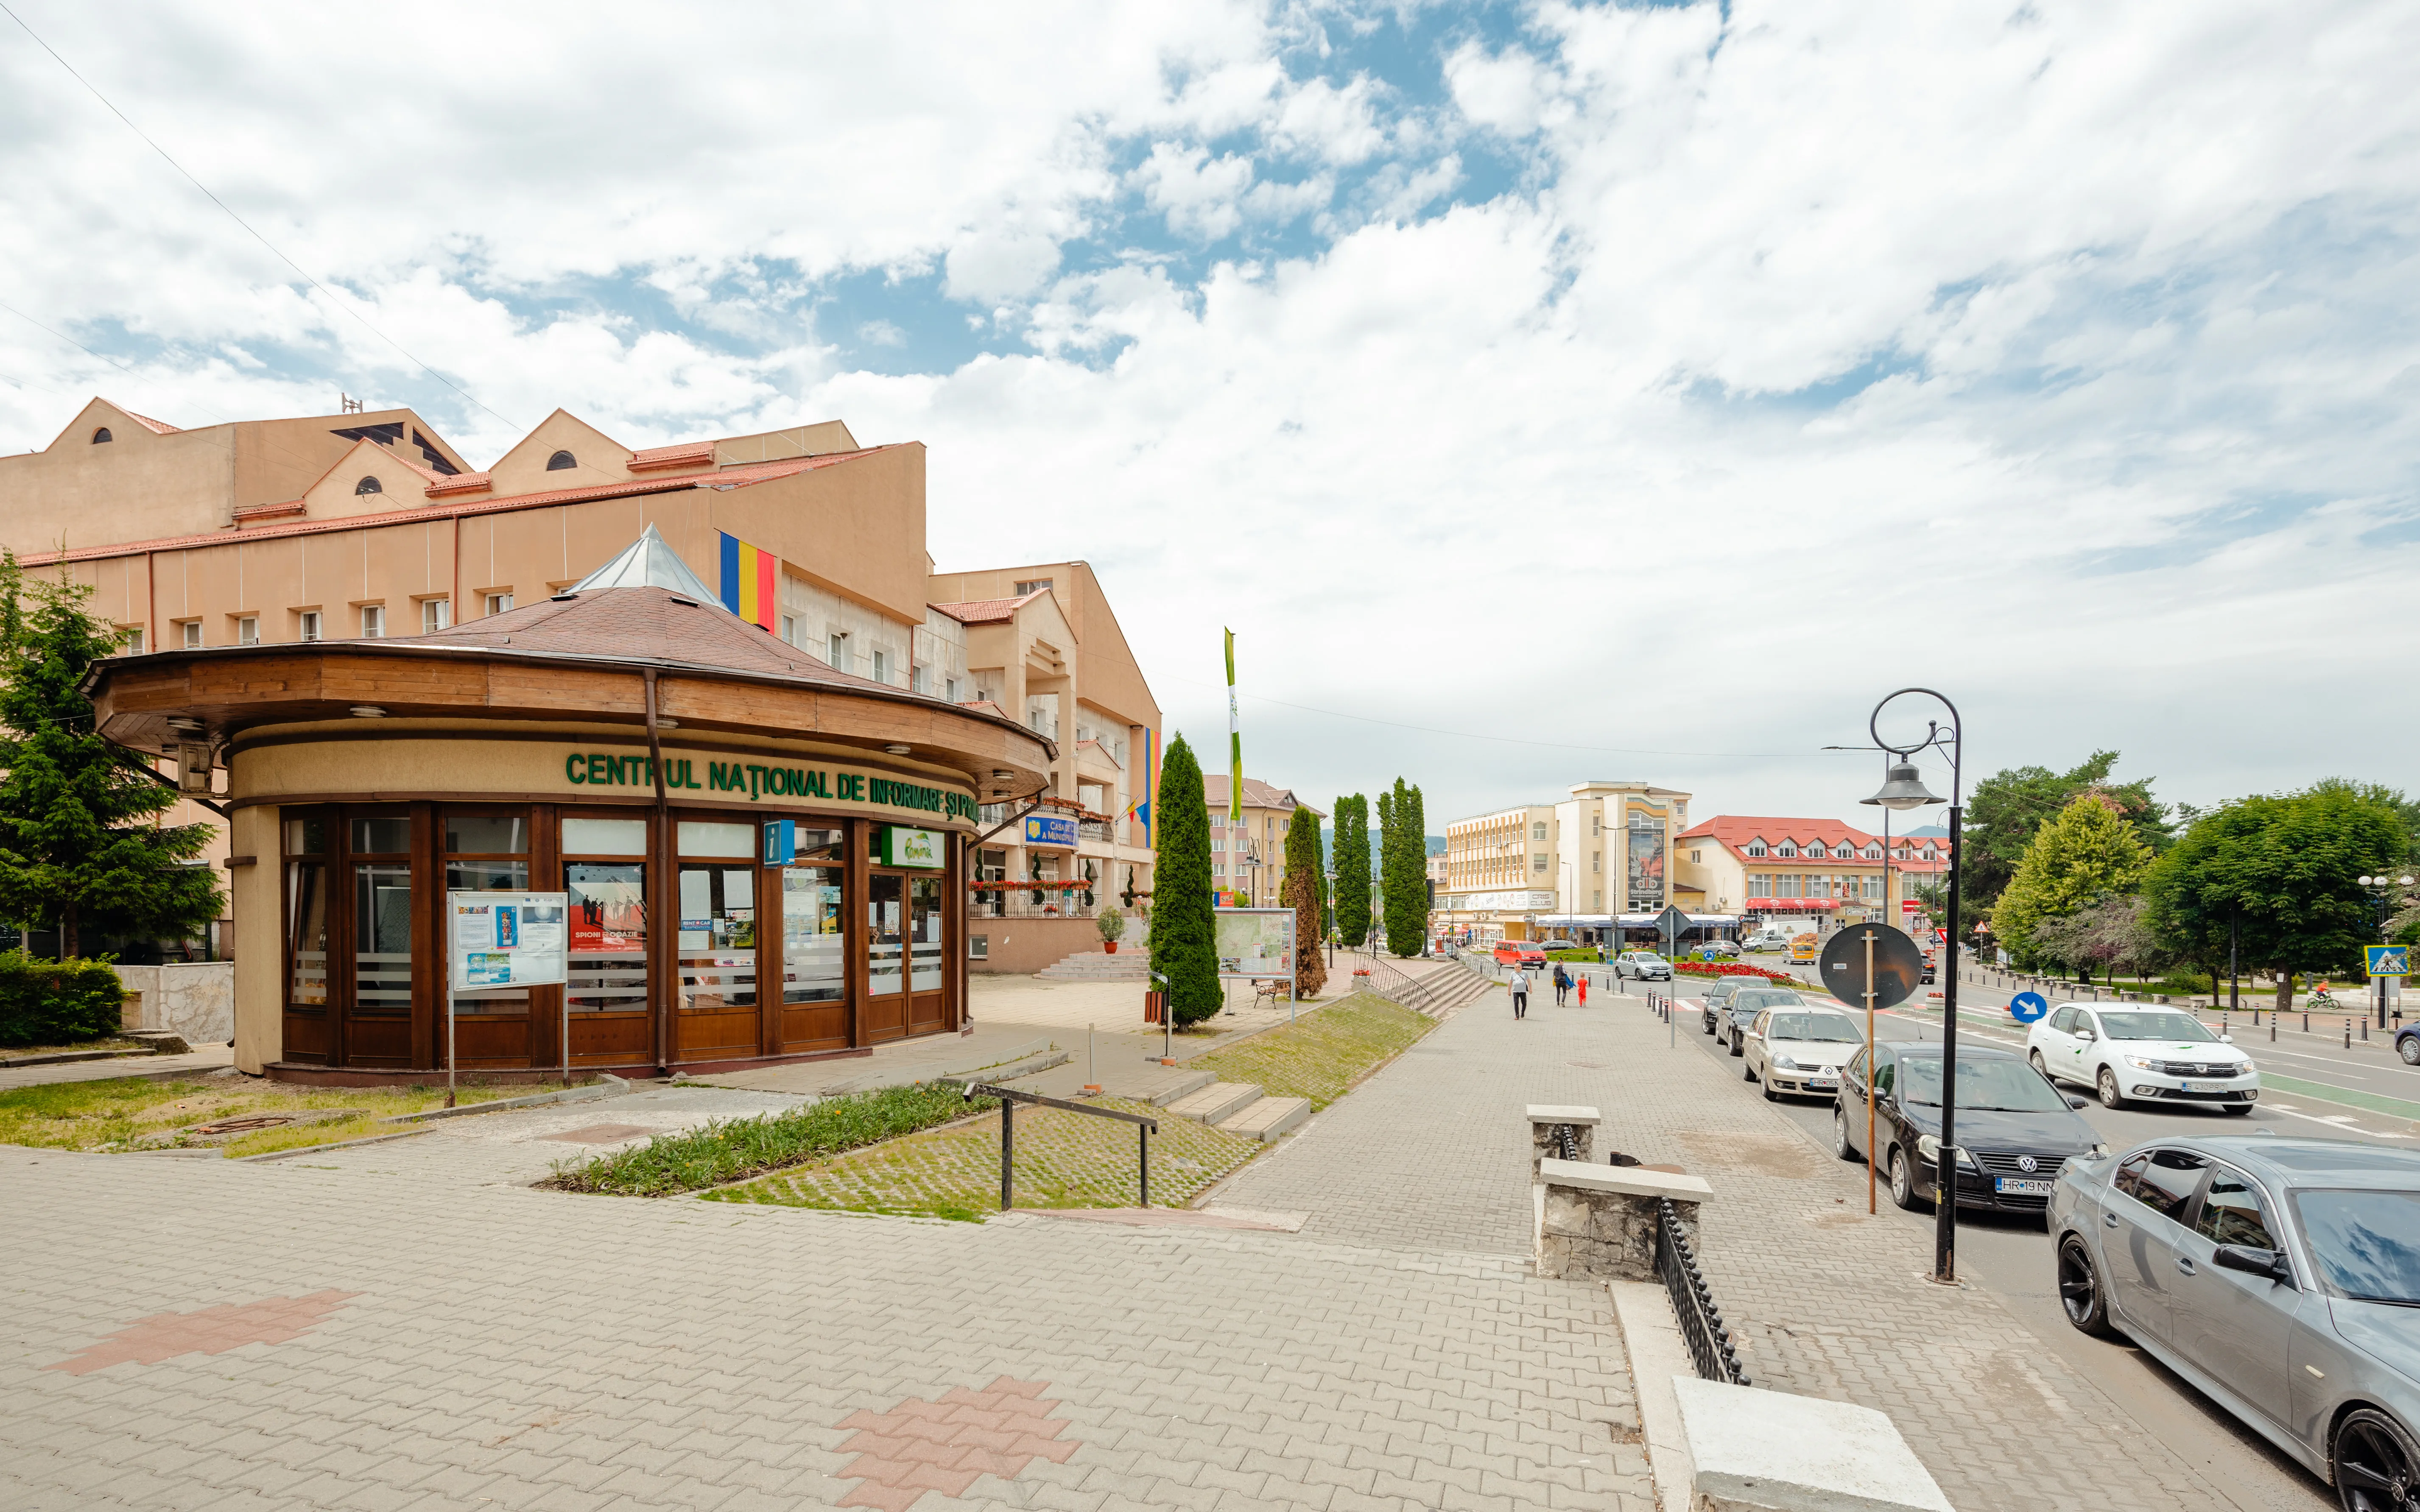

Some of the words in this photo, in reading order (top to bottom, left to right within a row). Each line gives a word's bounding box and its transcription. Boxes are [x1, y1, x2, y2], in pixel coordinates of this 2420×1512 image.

[838, 773, 865, 801] DE
[870, 778, 945, 813] INFORMARE
[2004, 1180, 2019, 1190] HR
[2025, 1181, 2034, 1191] 19
